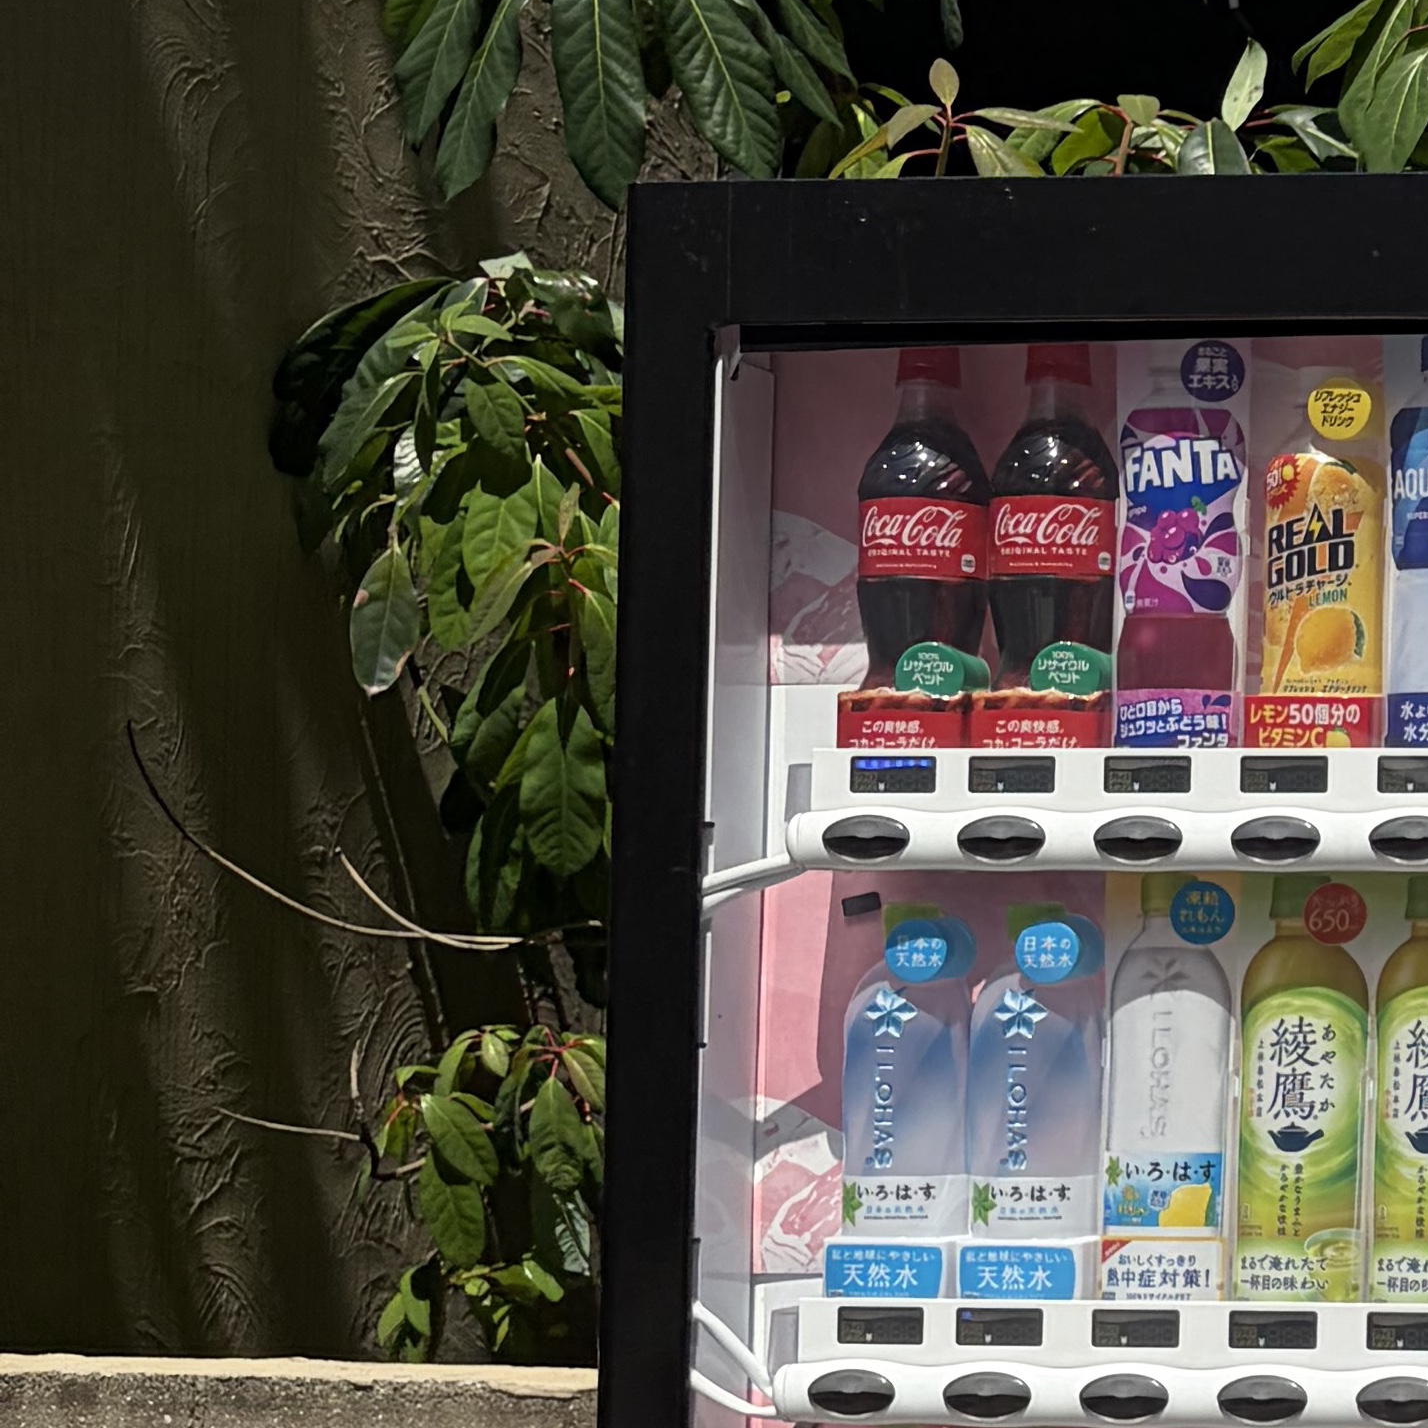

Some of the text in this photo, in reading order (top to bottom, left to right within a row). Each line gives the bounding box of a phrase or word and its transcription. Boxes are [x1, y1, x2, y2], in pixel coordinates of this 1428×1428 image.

[1320, 403, 1355, 415] エナジー
[1321, 415, 1355, 428] ドリンク
[1123, 439, 1238, 492] FANTA
[862, 505, 968, 548] Coca-Cola
[994, 503, 1102, 547] Coca-Cola
[1267, 503, 1355, 557] REAL
[1267, 541, 1355, 590] GOLD
[1308, 588, 1348, 607] LEMON
[902, 660, 954, 673] リサイクル
[1037, 659, 1090, 672] リサイクル
[912, 672, 945, 686] ペット
[1250, 703, 1361, 726] レモン50個分の
[1258, 727, 1324, 747] ビタミンC
[1023, 953, 1073, 969] 天然水
[1267, 1015, 1319, 1120] 綾鷹
[1319, 1023, 1336, 1112] あやたか
[1118, 1253, 1197, 1267] おいしくすっきり
[1240, 1254, 1327, 1271] まるで淹れたて
[842, 1262, 919, 1289] 天然水
[976, 1264, 1053, 1291] 天然水
[1240, 1274, 1329, 1292] 一杯目の味わい
